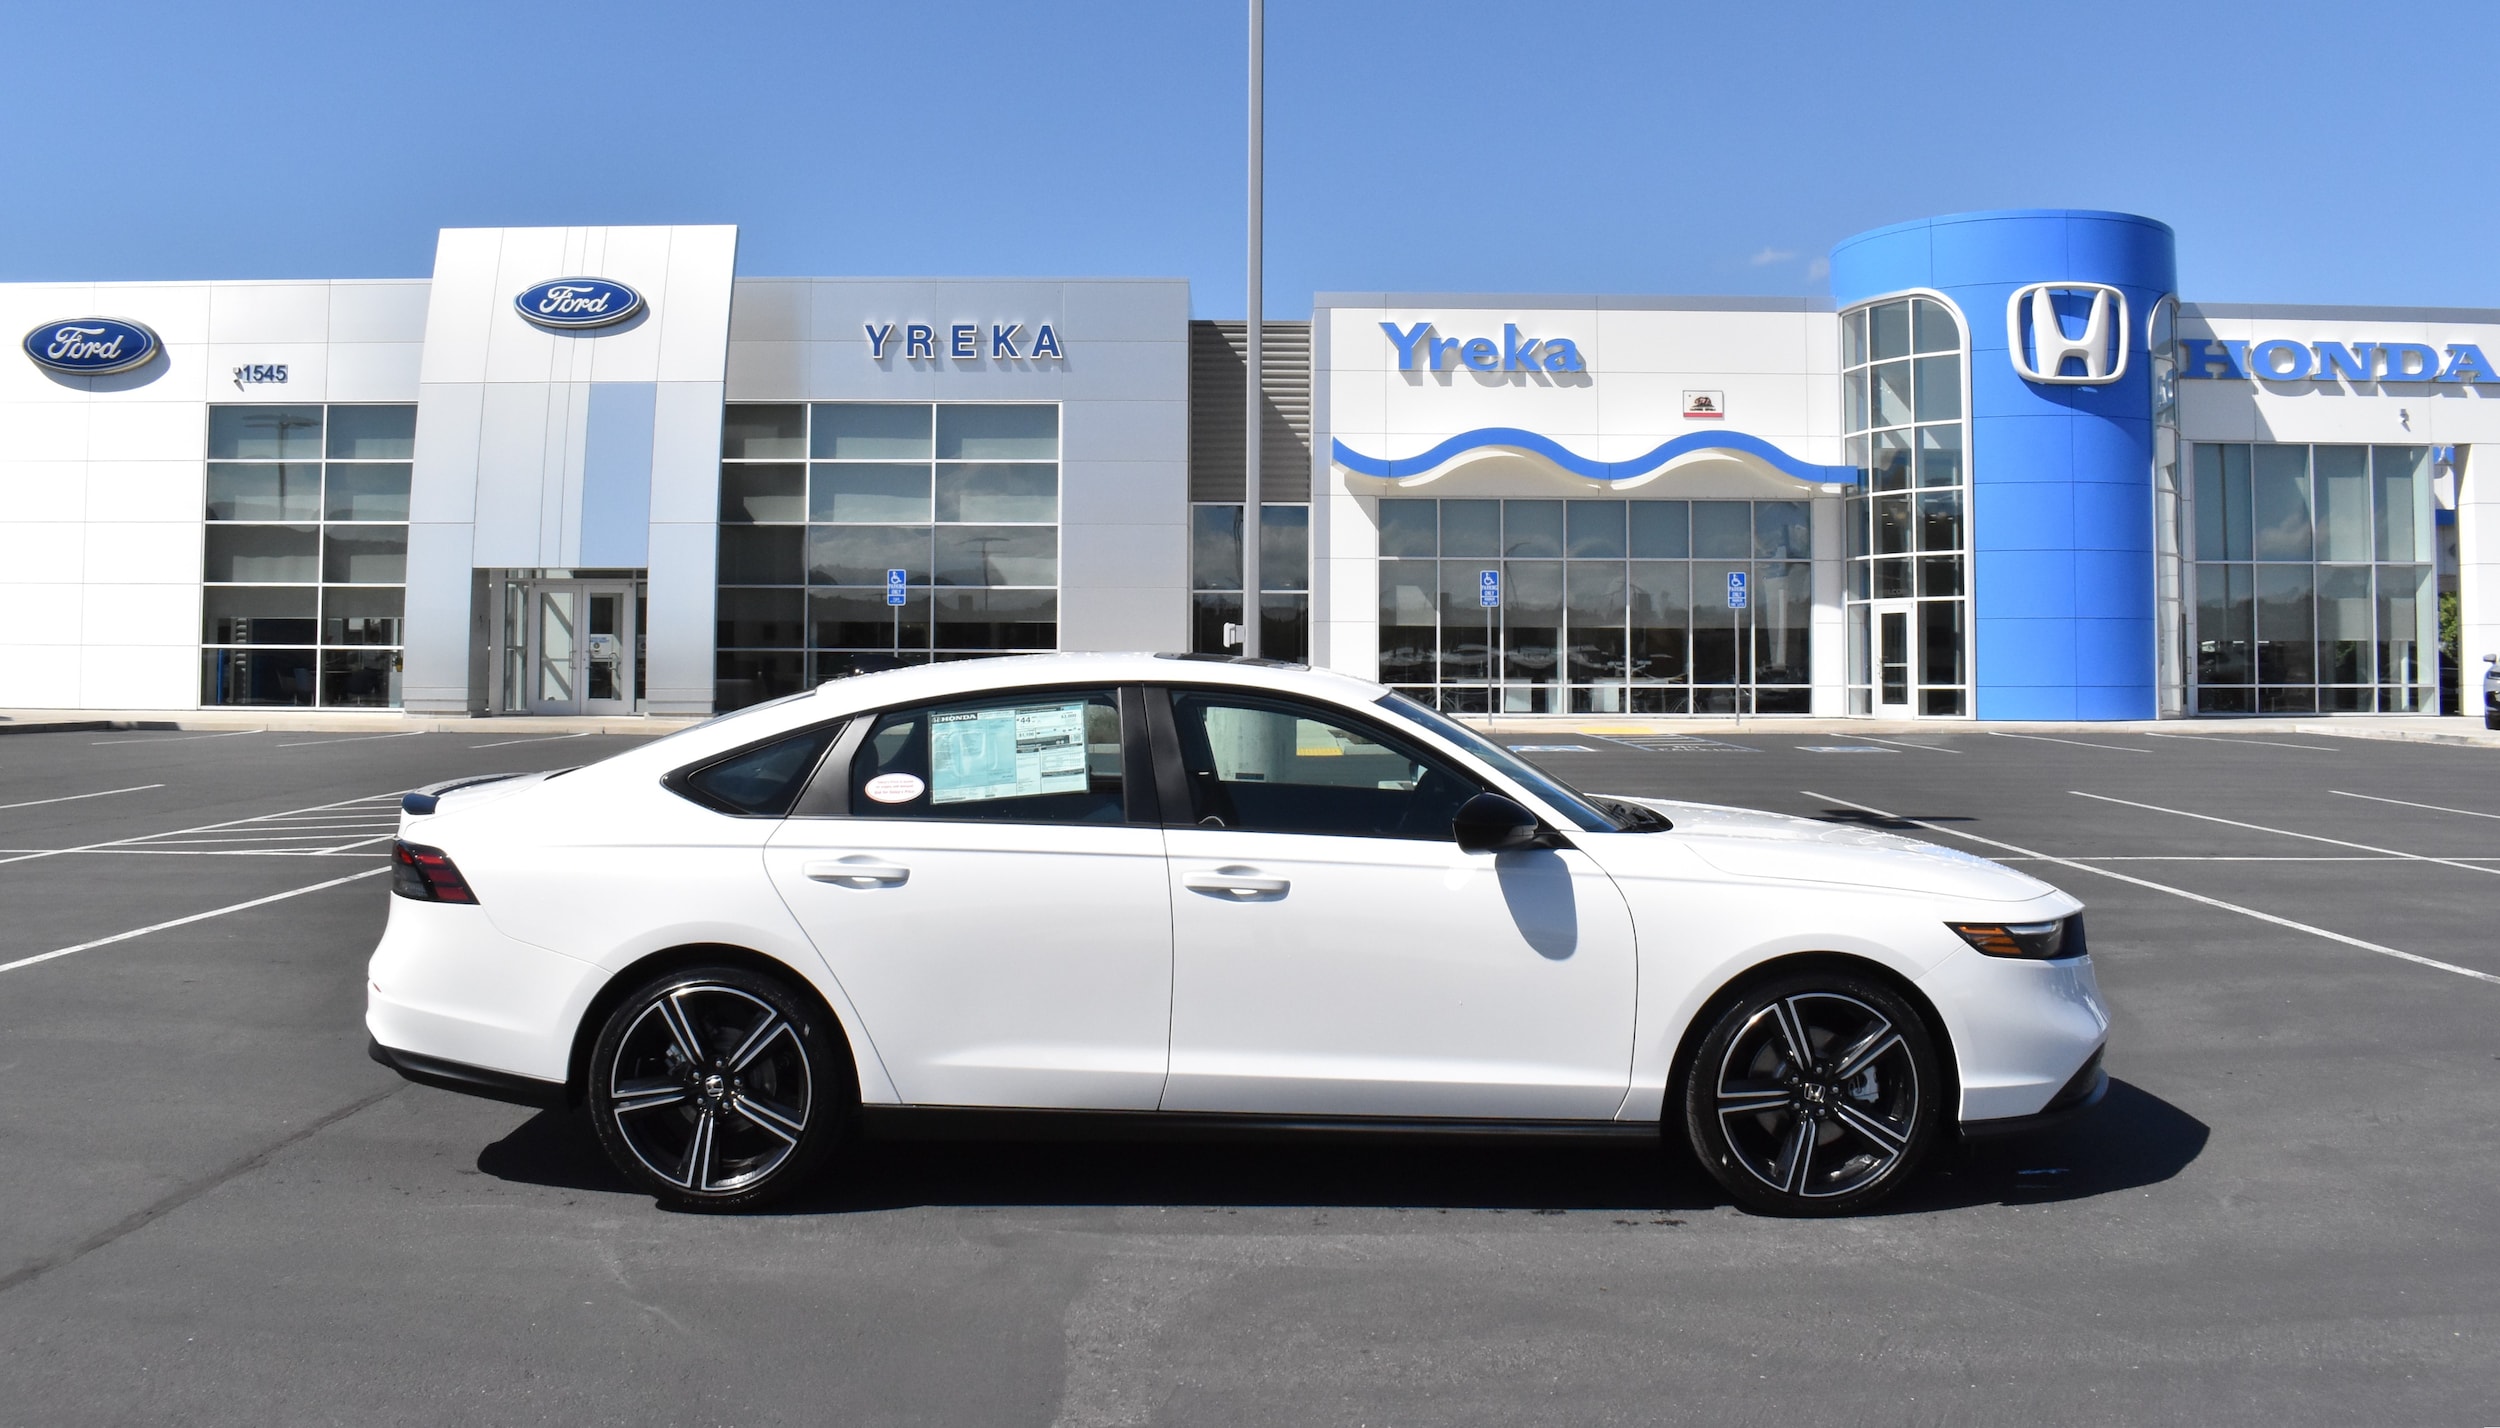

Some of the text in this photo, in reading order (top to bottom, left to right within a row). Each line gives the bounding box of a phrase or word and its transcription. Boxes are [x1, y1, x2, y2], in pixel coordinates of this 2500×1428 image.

[540, 286, 611, 313] Ford
[48, 326, 123, 359] Ford
[863, 323, 1063, 359] YREKA
[1378, 322, 1583, 372] Yreka
[243, 364, 288, 382] 1545
[2179, 338, 2500, 384] HONDA
[941, 713, 977, 722] HONDA
